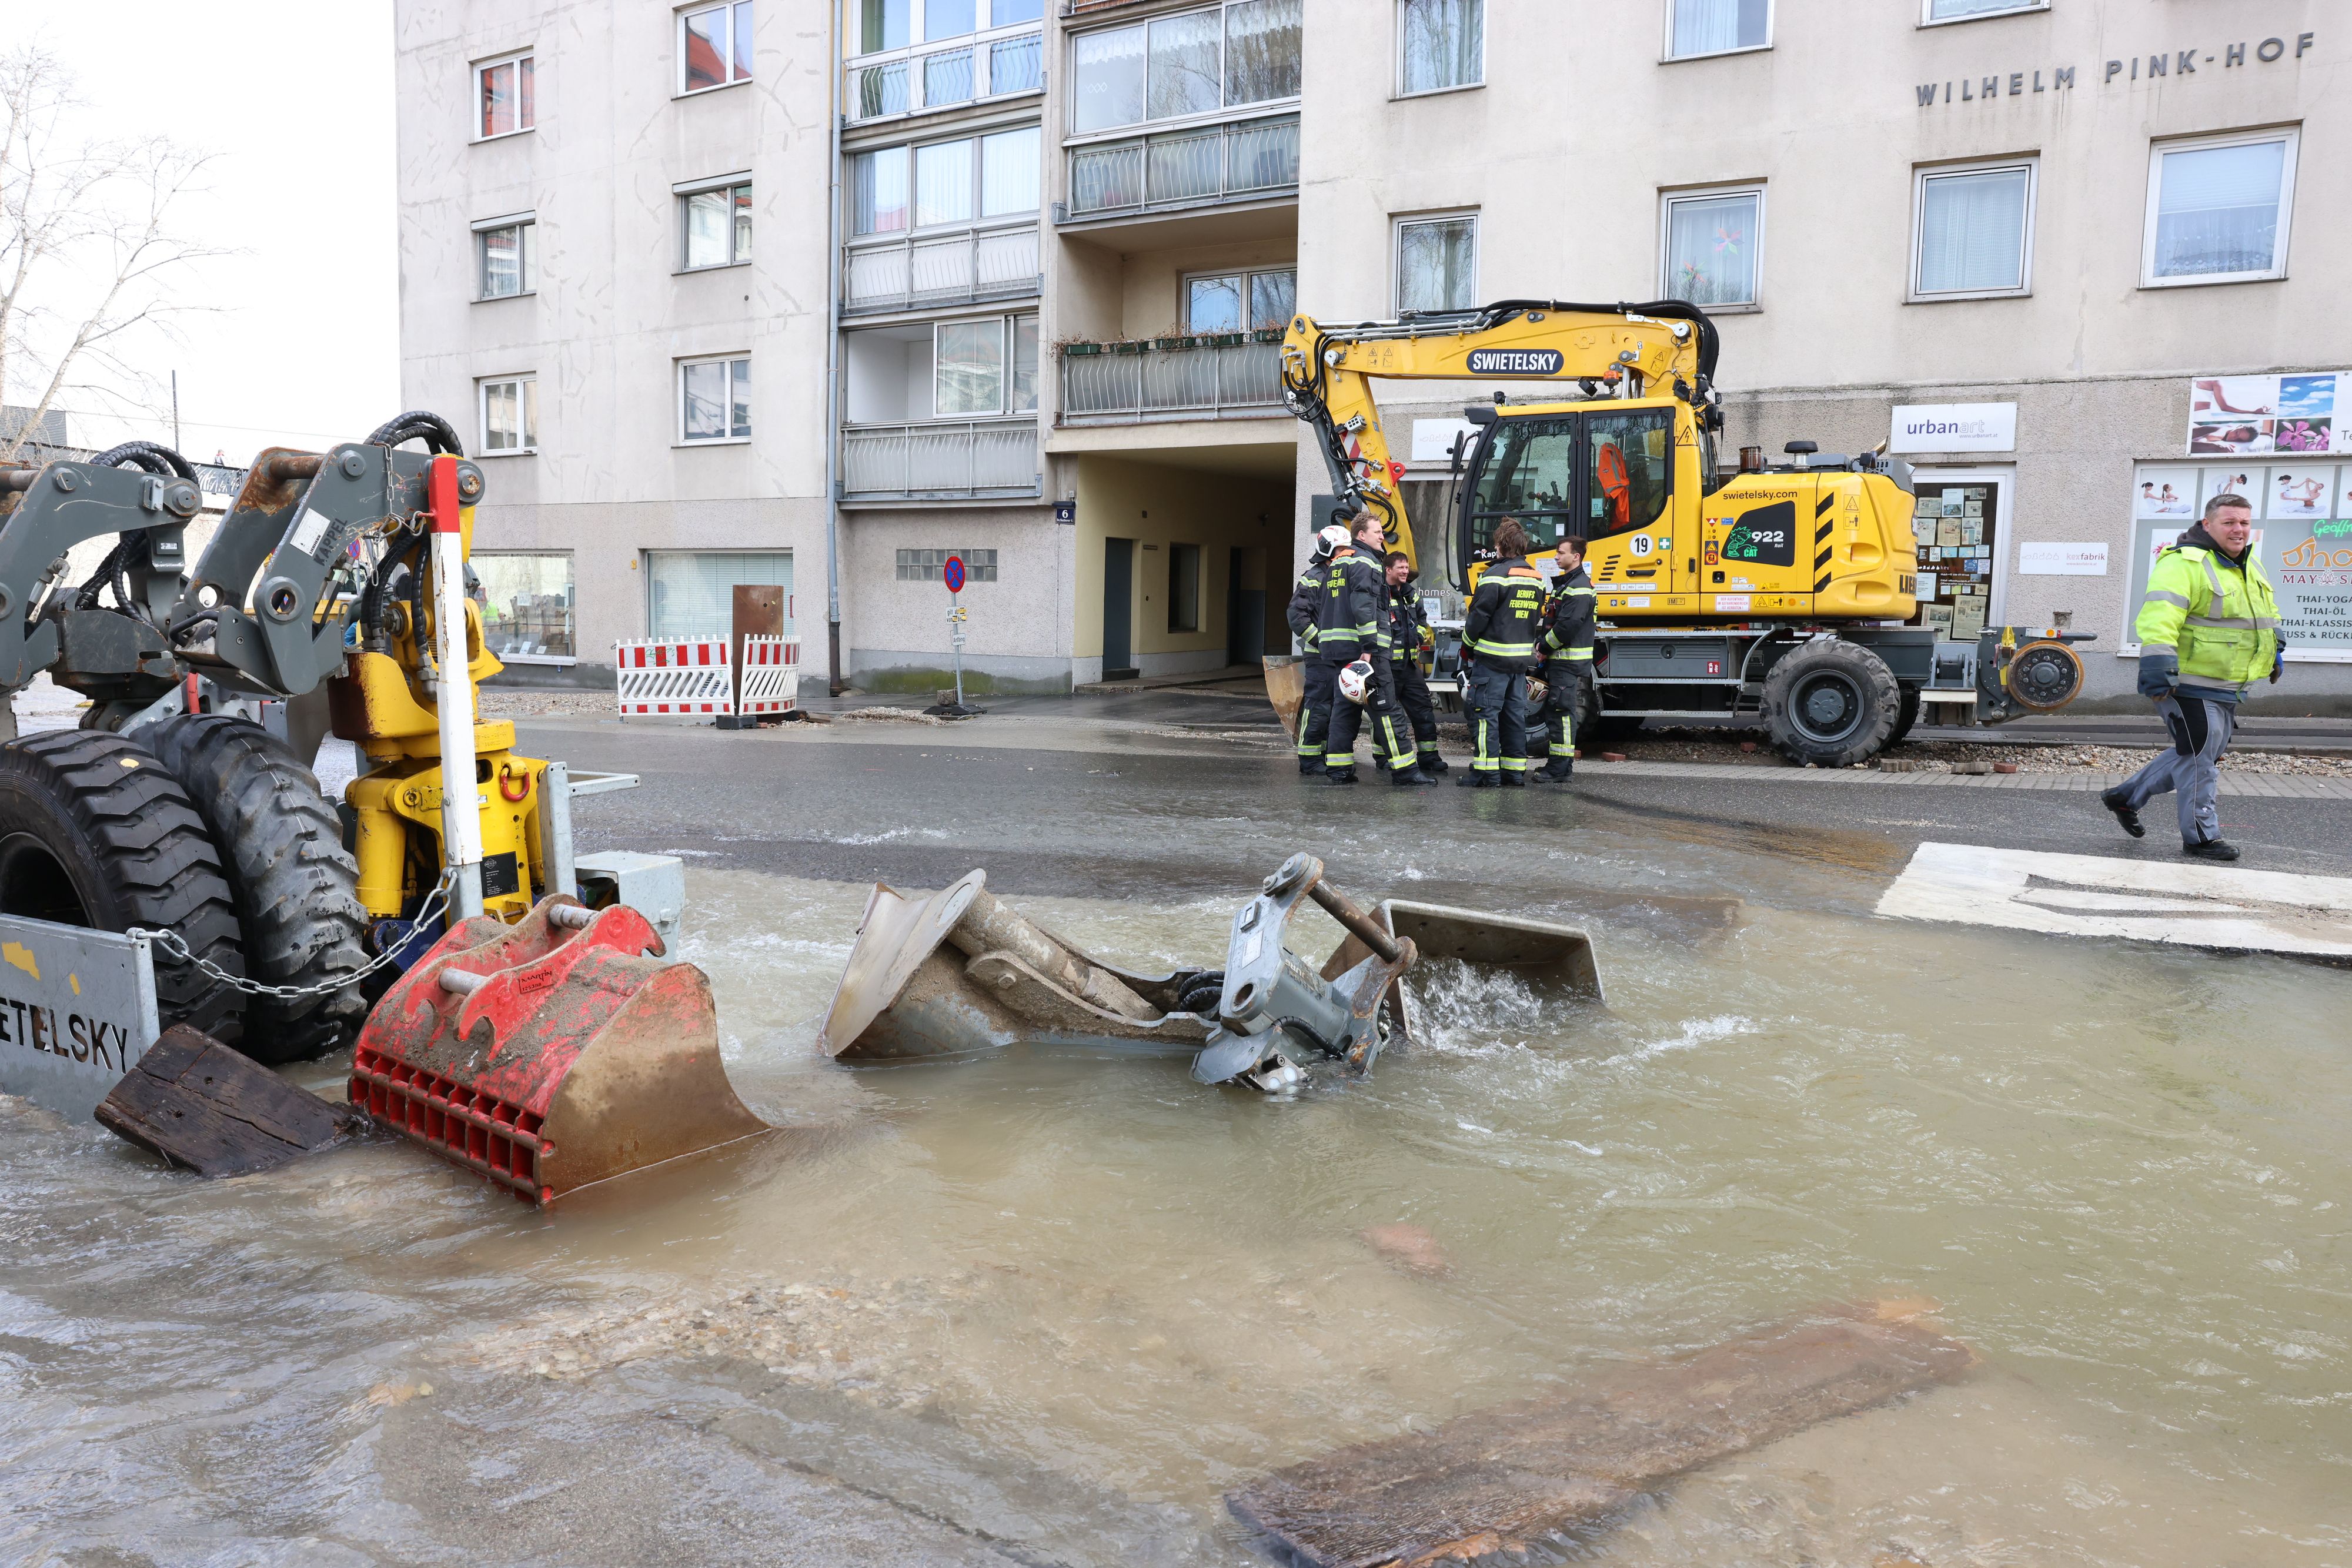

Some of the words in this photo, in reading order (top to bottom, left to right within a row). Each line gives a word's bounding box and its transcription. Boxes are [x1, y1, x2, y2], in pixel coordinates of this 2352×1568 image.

[1916, 66, 2076, 106] WILHELM
[2104, 32, 2314, 83] PINK-HOF
[1472, 353, 1558, 370] SWIETELSKY
[1907, 419, 1985, 434] urbanart
[1723, 490, 1798, 500] swietelsky.com
[1062, 509, 1068, 519] 6
[1751, 530, 1784, 543] 922
[1635, 537, 1648, 553] 19
[1743, 549, 1758, 557] CAT
[2282, 574, 2317, 584] MAY
[1516, 590, 1535, 599] BERUFS
[1509, 599, 1539, 610] FEUERWEHR
[1515, 610, 1529, 619] WIEN
[2303, 606, 2346, 615] THAI-ÖL
[2321, 630, 2352, 639] RÜCK
